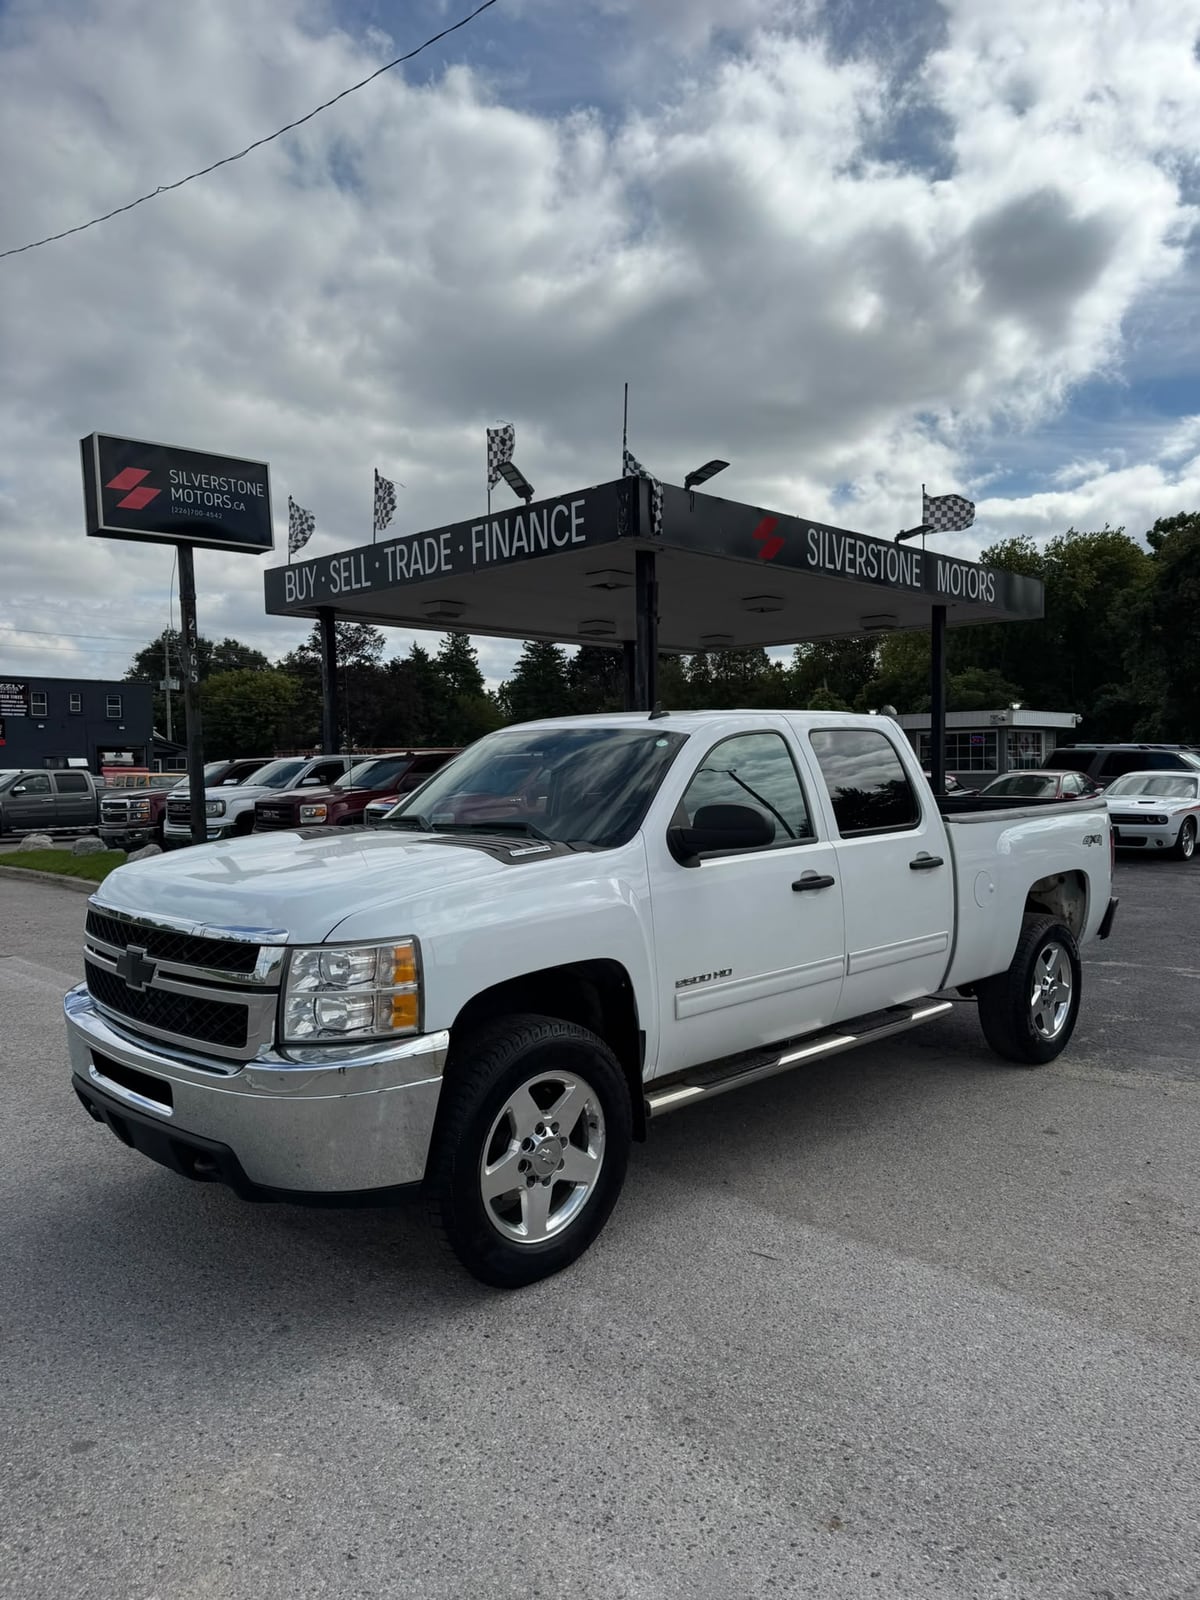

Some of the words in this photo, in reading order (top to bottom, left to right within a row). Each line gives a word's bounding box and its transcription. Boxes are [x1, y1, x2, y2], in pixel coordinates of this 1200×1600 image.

[169, 469, 264, 497] SILVERSTONE
[285, 564, 317, 602] BUY
[329, 553, 371, 593] SELL
[384, 533, 452, 582] TRADE
[471, 499, 586, 564] FINANCE
[807, 528, 921, 587] SILVERSTONE
[937, 560, 995, 602] MOTORS
[188, 617, 198, 683] 2365
[675, 973, 711, 988] 2500
[713, 968, 732, 980] HD
